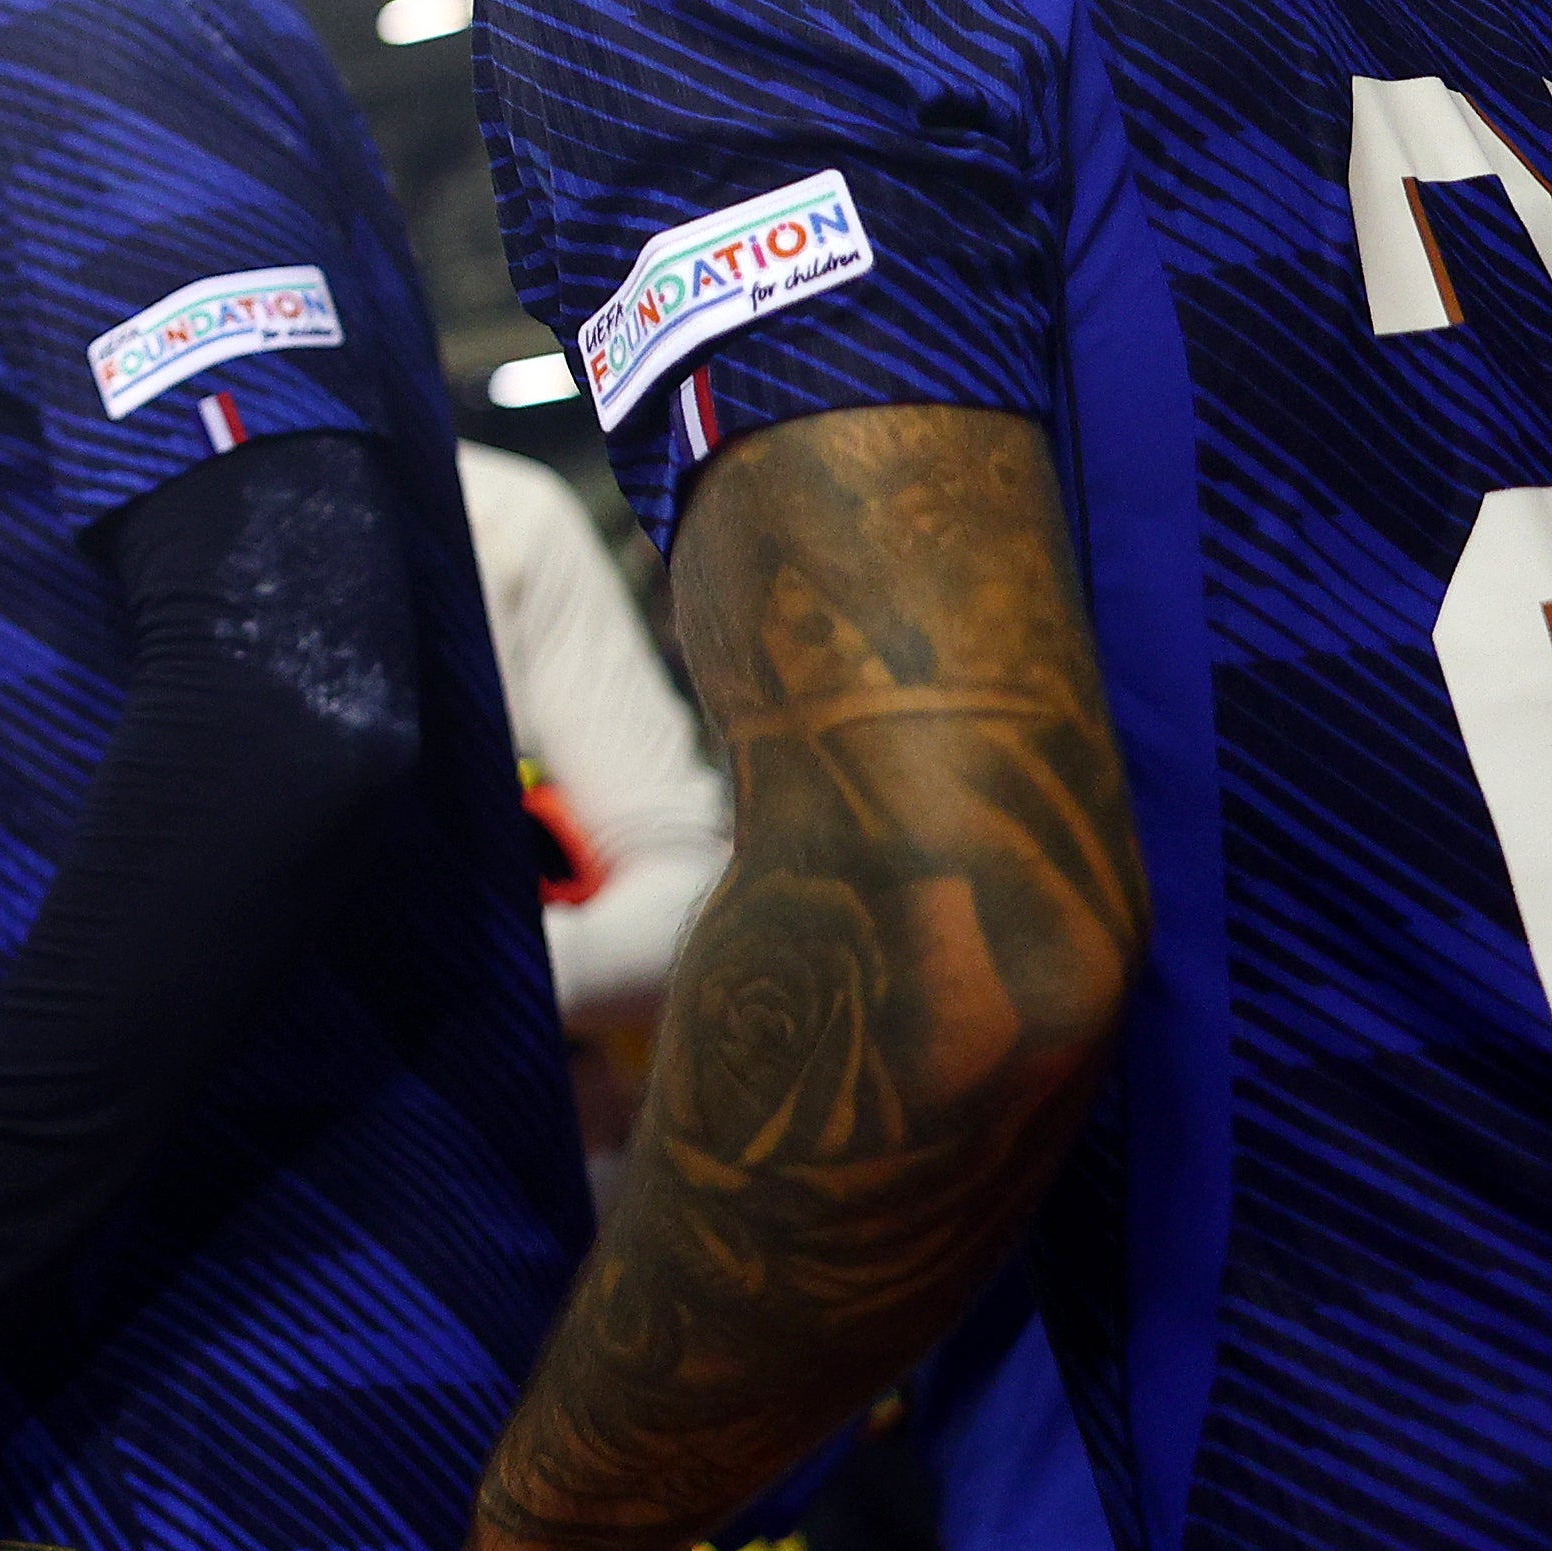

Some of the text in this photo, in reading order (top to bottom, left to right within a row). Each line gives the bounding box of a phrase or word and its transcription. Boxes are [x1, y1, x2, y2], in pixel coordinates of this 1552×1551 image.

[590, 202, 850, 393] FOUNDATION
[751, 248, 861, 313] for children
[102, 294, 327, 385] FOUNDATION
[586, 300, 625, 354] UEFA
